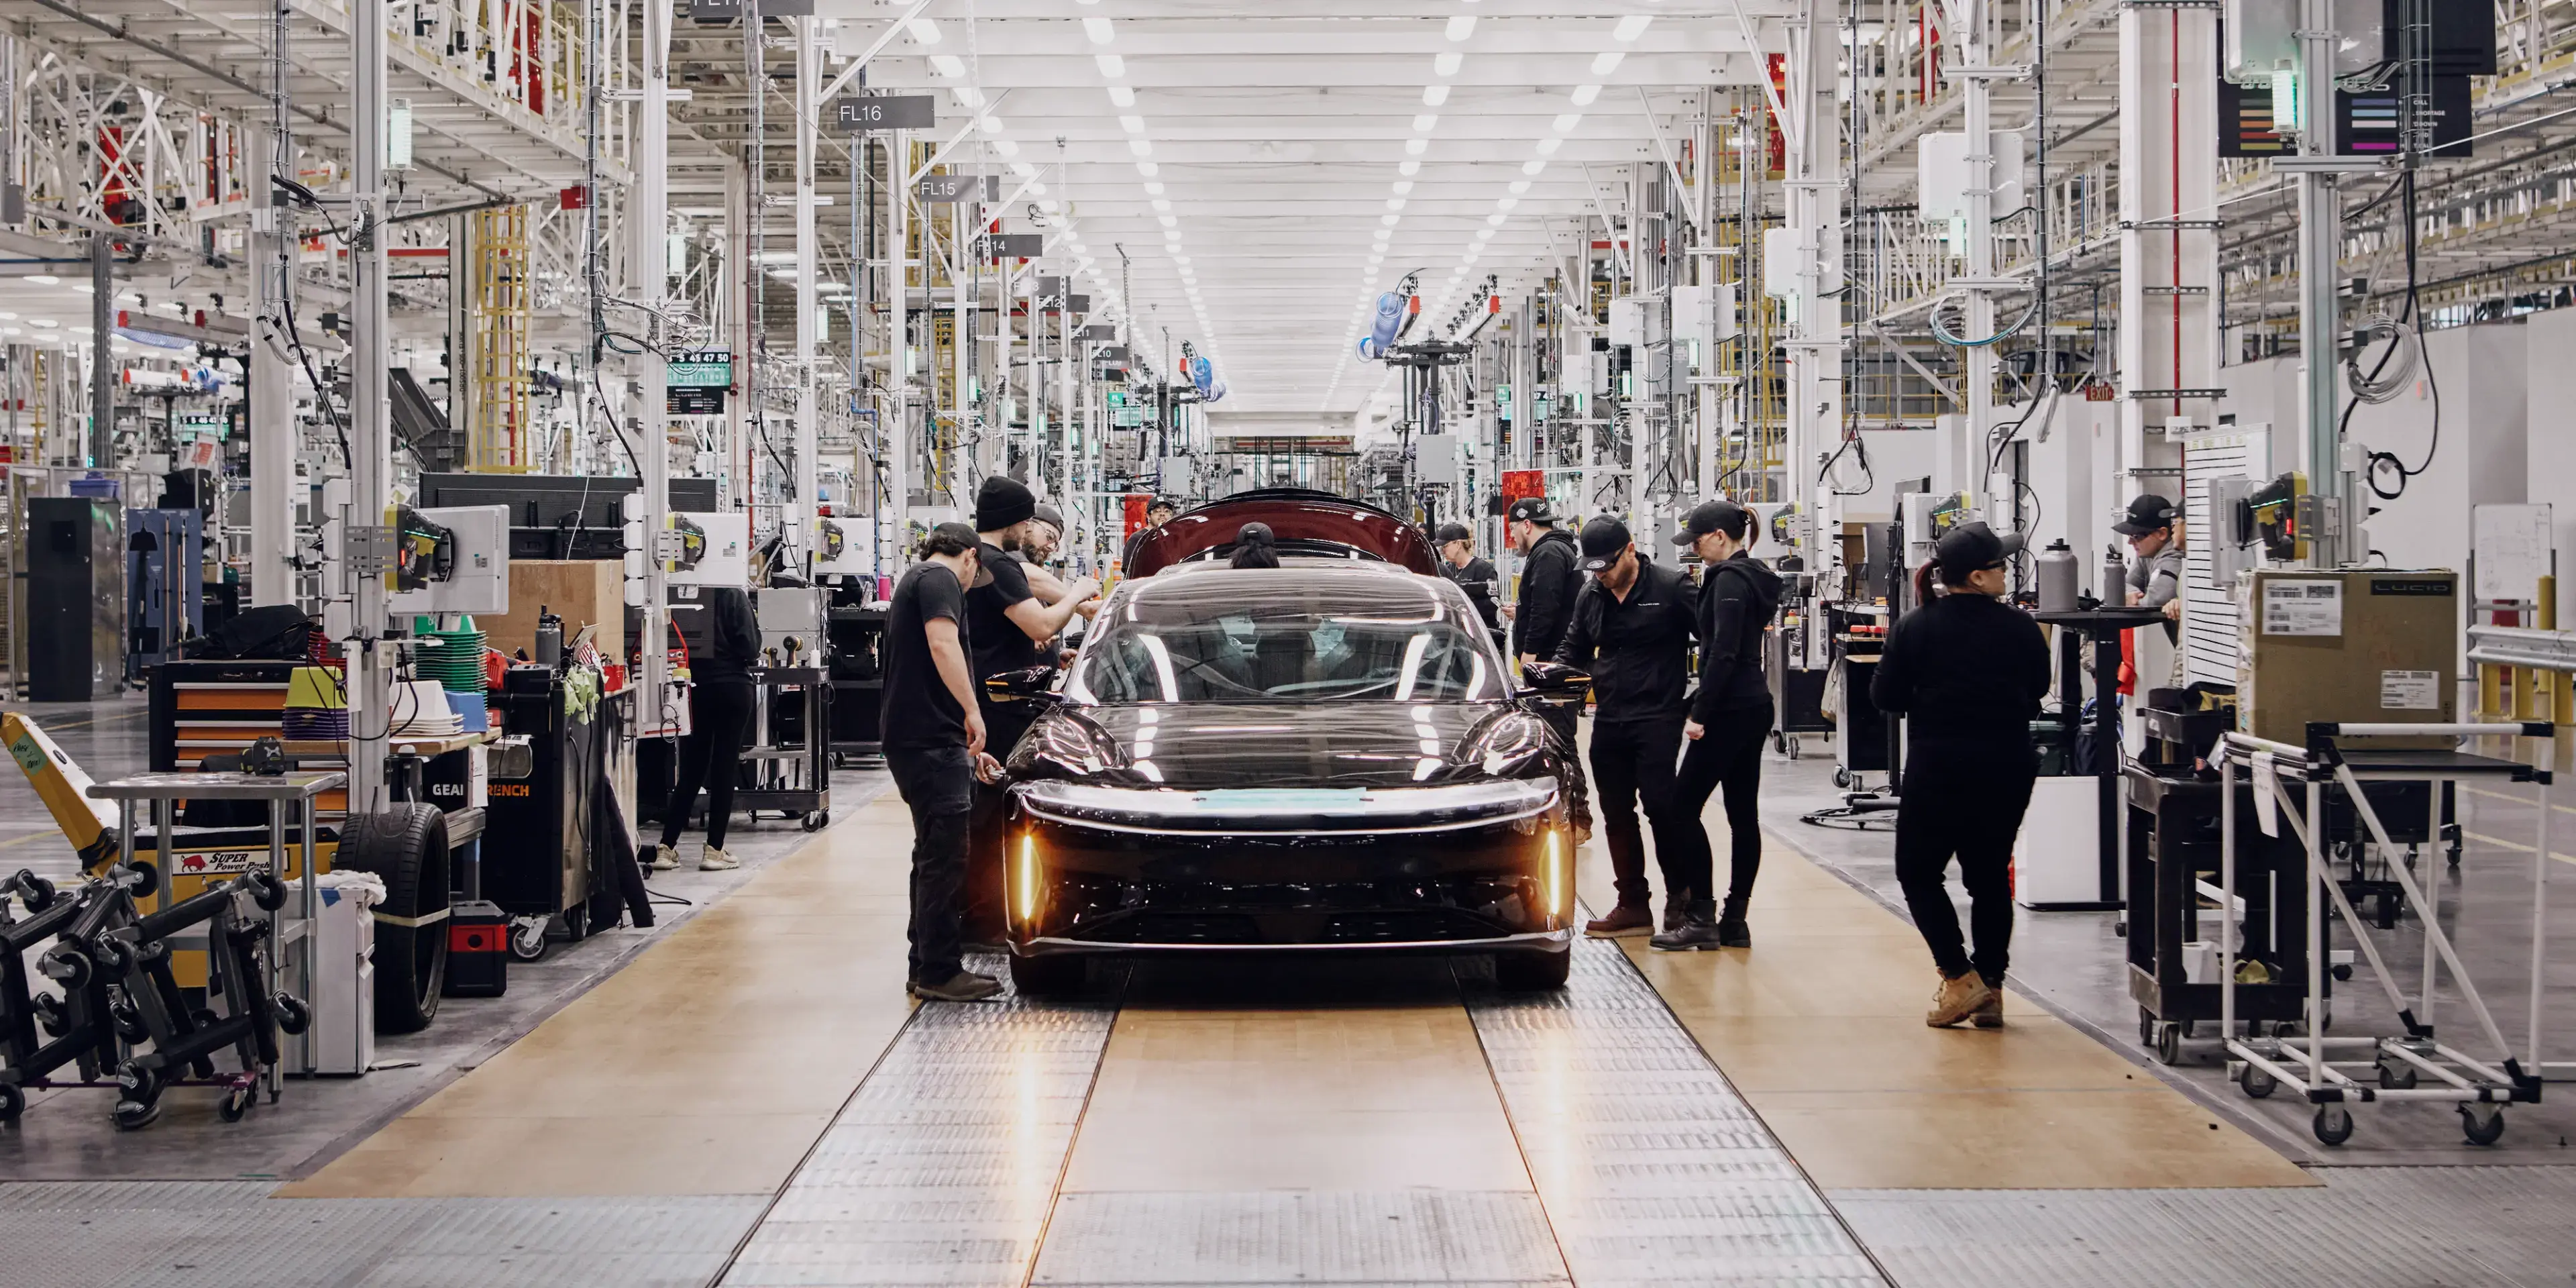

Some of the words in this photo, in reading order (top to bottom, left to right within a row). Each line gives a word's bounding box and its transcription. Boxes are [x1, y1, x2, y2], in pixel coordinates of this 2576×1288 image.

[841, 105, 881, 121] FL16
[922, 182, 955, 195] FL15
[977, 240, 1006, 252] F14
[1014, 282, 1039, 292] F3
[703, 353, 714, 363] 47
[717, 353, 729, 363] 50
[2090, 386, 2108, 400] EXIT
[433, 784, 464, 796] GEA
[487, 785, 529, 796] RENCH
[209, 852, 249, 863] SUPER
[214, 863, 246, 871] Power
